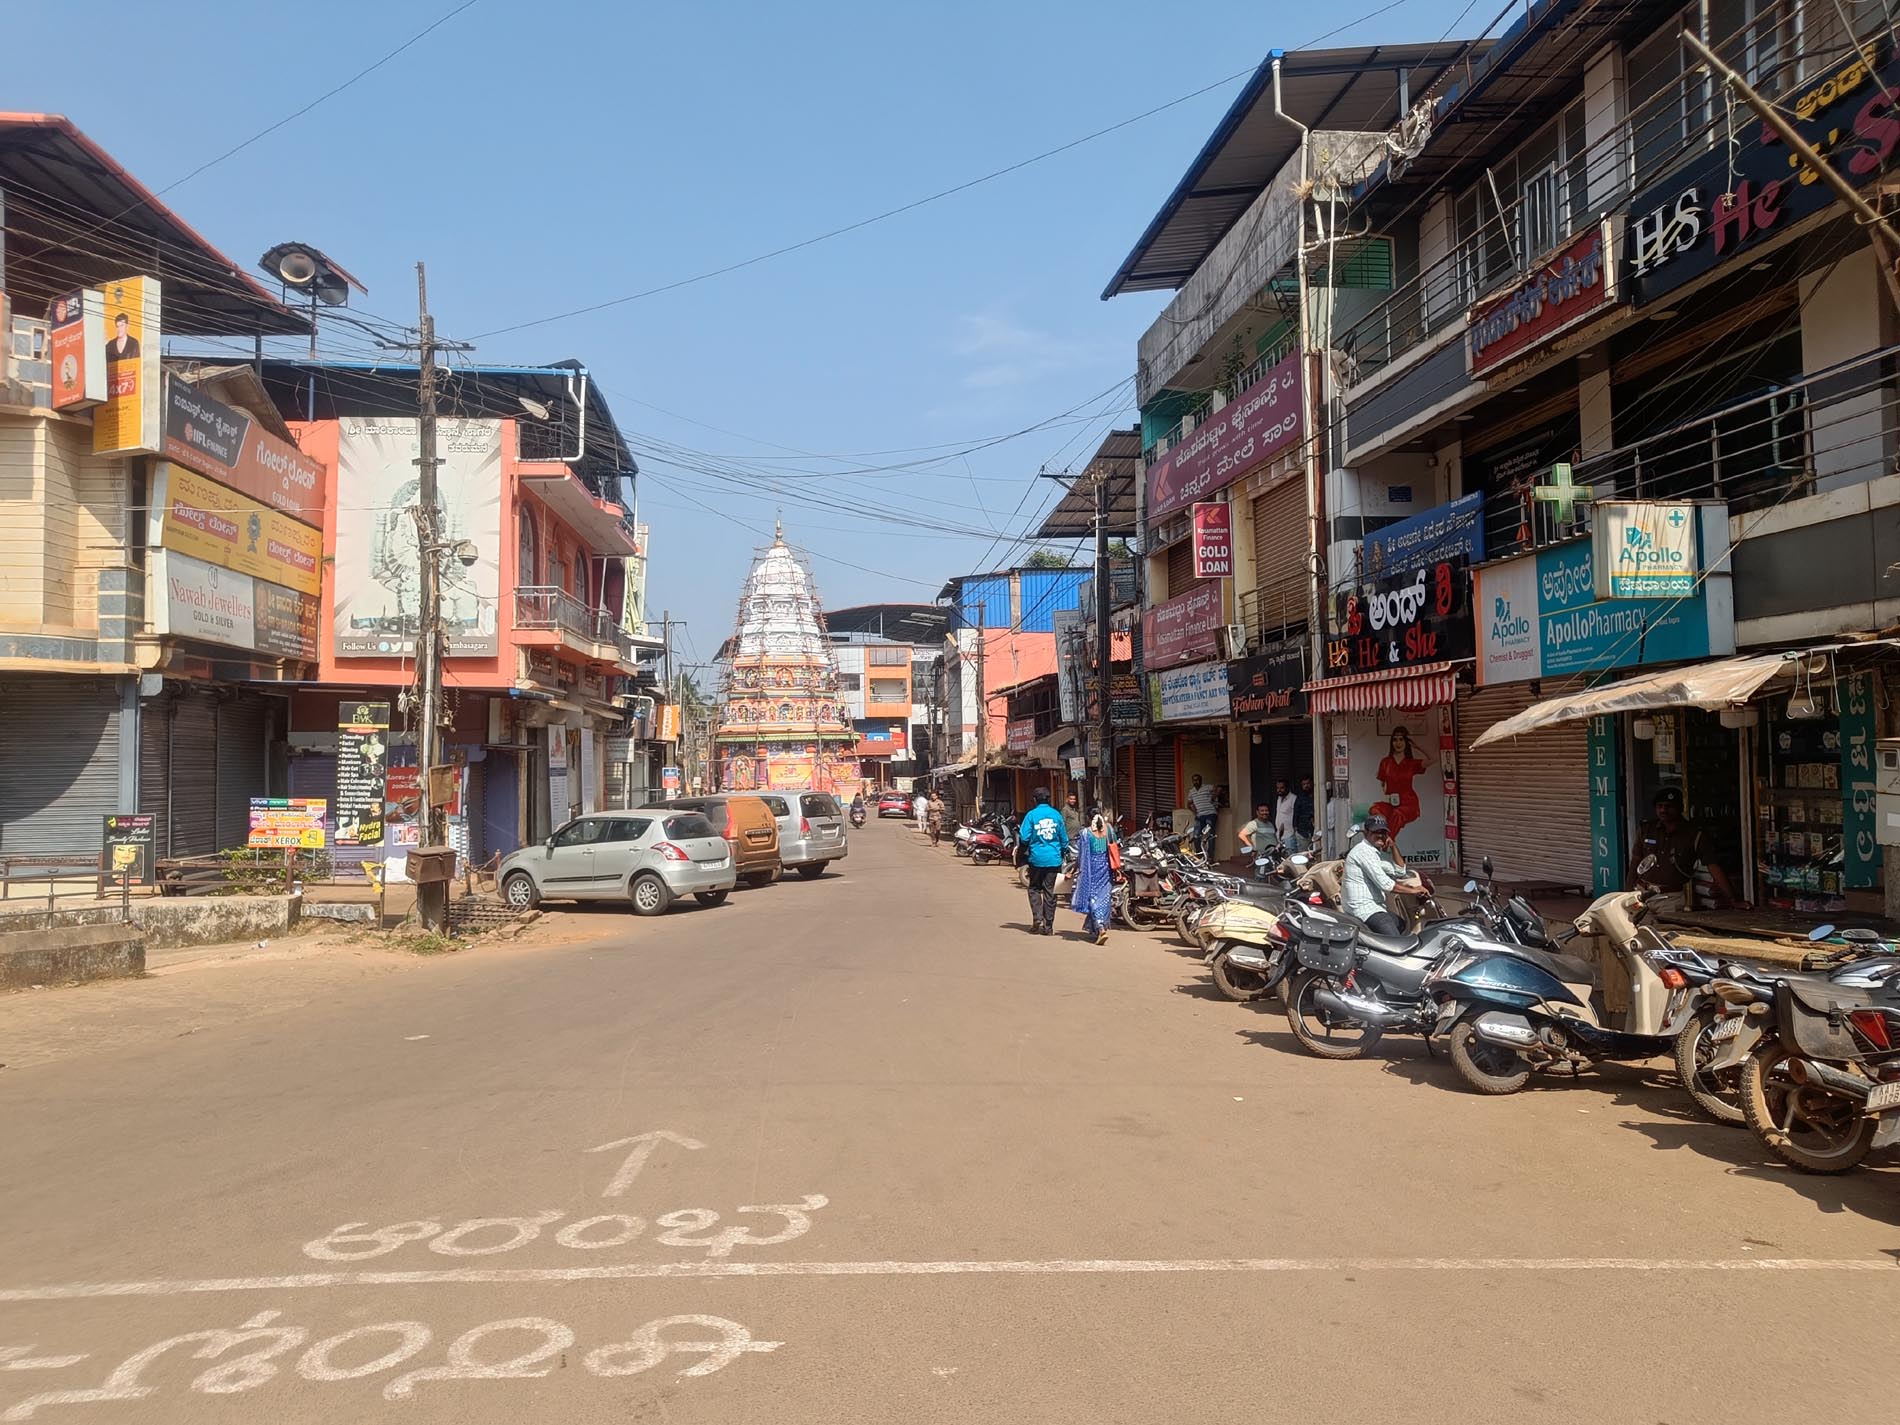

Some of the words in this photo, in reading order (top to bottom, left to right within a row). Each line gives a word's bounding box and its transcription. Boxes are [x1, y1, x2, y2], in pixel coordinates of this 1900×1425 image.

[192, 428, 207, 449] IIFL
[1179, 468, 1211, 501] ಚಿನ್ನದ
[1216, 437, 1255, 476] ಮೇಲೆ
[1262, 412, 1297, 447] ಸಾಲ
[1199, 545, 1228, 558] GOLD
[1618, 547, 1683, 570] Apollo
[1200, 561, 1229, 573] LOAN
[1620, 577, 1690, 592] ಔಷಧಾಲಯ
[171, 577, 207, 610] Nawab
[208, 589, 252, 620] Jewellers
[1369, 569, 1426, 630] ಅಂಡ್
[193, 610, 209, 623] GOLD
[215, 615, 234, 629] SILVER
[1491, 617, 1530, 647] Apollo
[342, 641, 366, 651] Follow
[366, 641, 378, 651] Us
[1328, 639, 1349, 668] HS
[1359, 637, 1380, 668] He
[1389, 641, 1400, 663] &
[1405, 621, 1438, 661] She
[1504, 637, 1531, 647] PHARMACY
[1489, 650, 1508, 665] Chemist
[1513, 647, 1535, 662] Druggist
[1233, 694, 1264, 720] Fashion
[1593, 716, 1610, 888] HEMIST
[360, 821, 381, 834] Hydra
[360, 829, 381, 841] Facial
[1402, 854, 1440, 863] TRENDY
